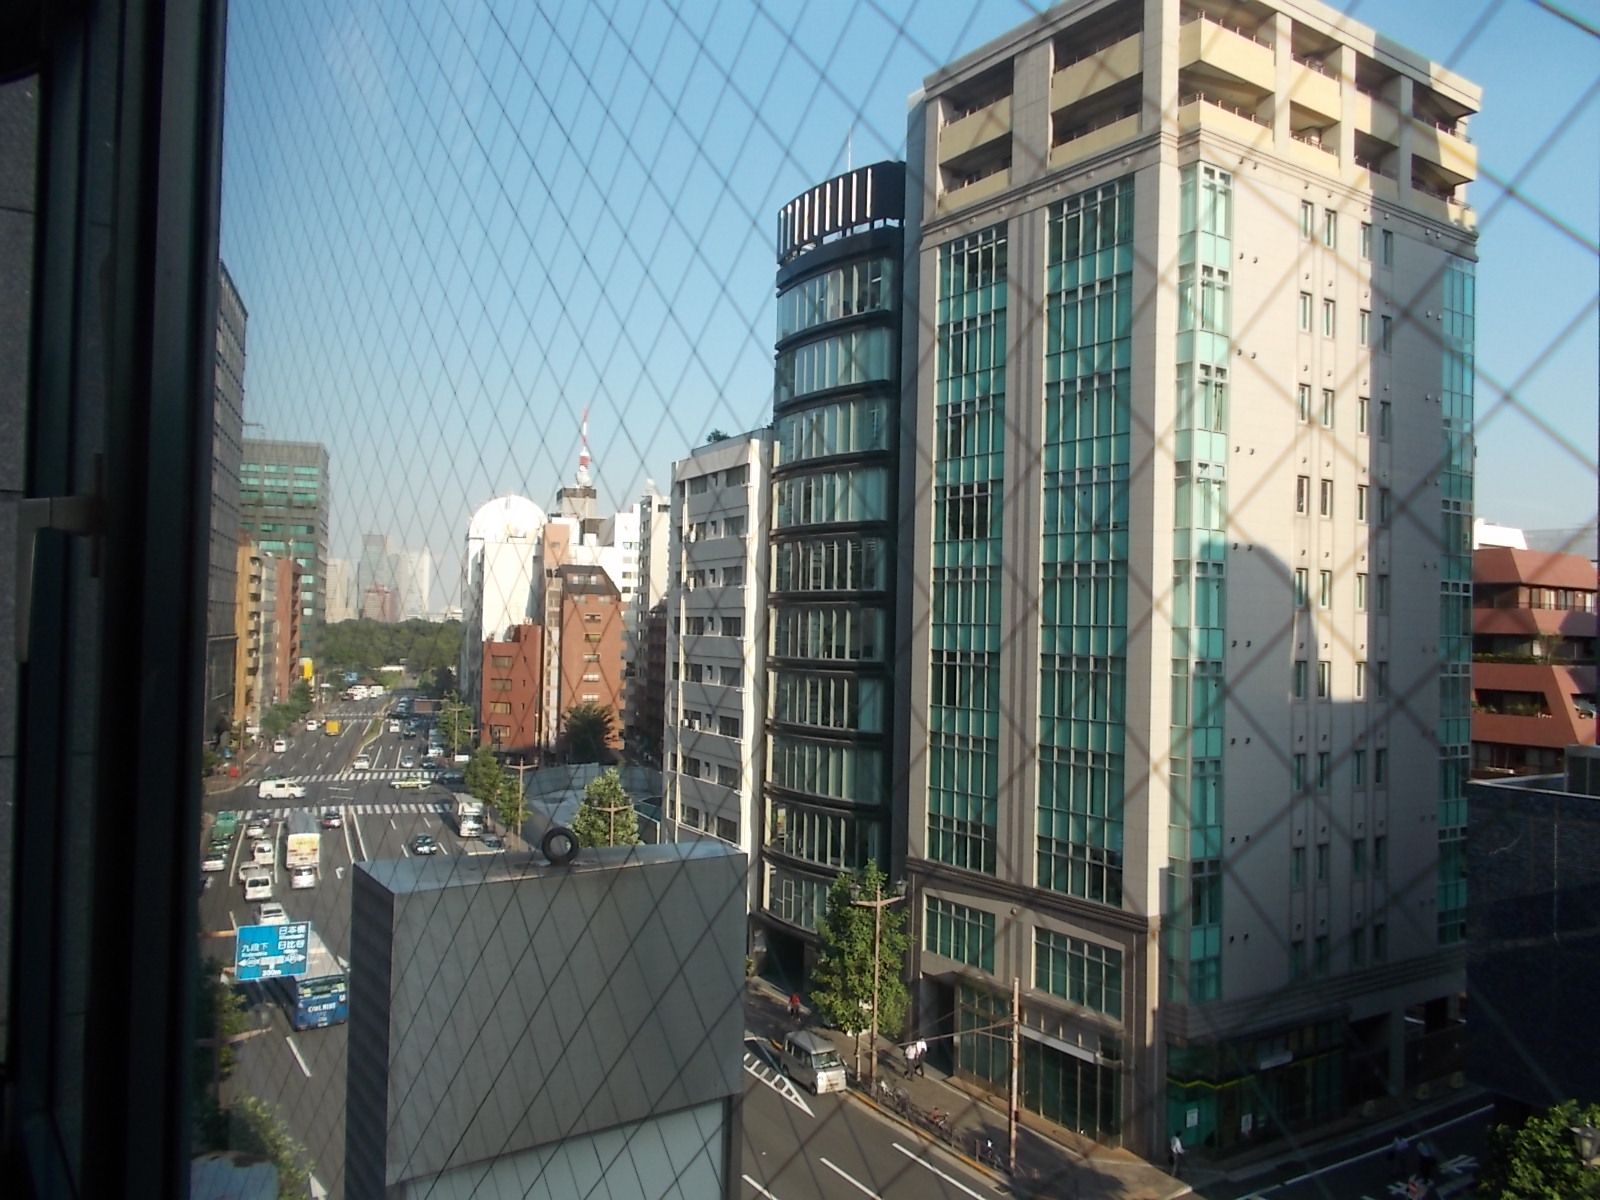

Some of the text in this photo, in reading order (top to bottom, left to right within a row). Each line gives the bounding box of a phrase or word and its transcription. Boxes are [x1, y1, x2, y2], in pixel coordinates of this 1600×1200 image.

[279, 925, 306, 934] 日本橋
[242, 943, 269, 952] 九段下
[278, 940, 304, 950] 日比谷
